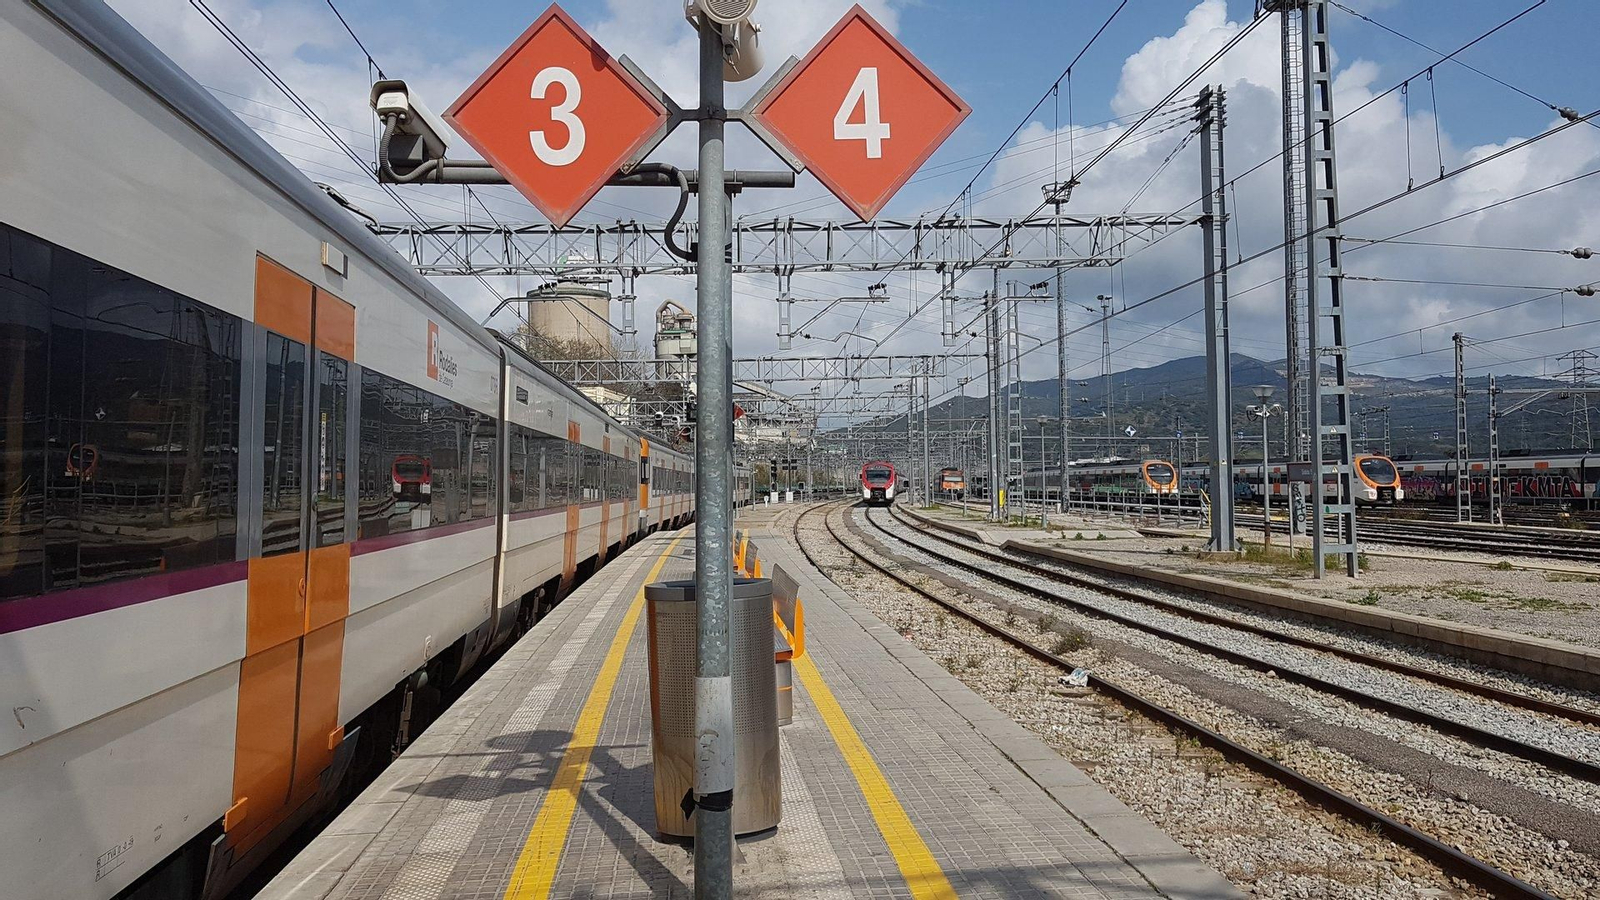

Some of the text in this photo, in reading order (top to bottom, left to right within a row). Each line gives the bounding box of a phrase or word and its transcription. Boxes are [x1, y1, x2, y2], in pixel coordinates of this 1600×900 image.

[530, 67, 585, 166] 3
[834, 67, 890, 158] 4
[431, 331, 438, 367] R
[439, 349, 458, 377] Rodalies
